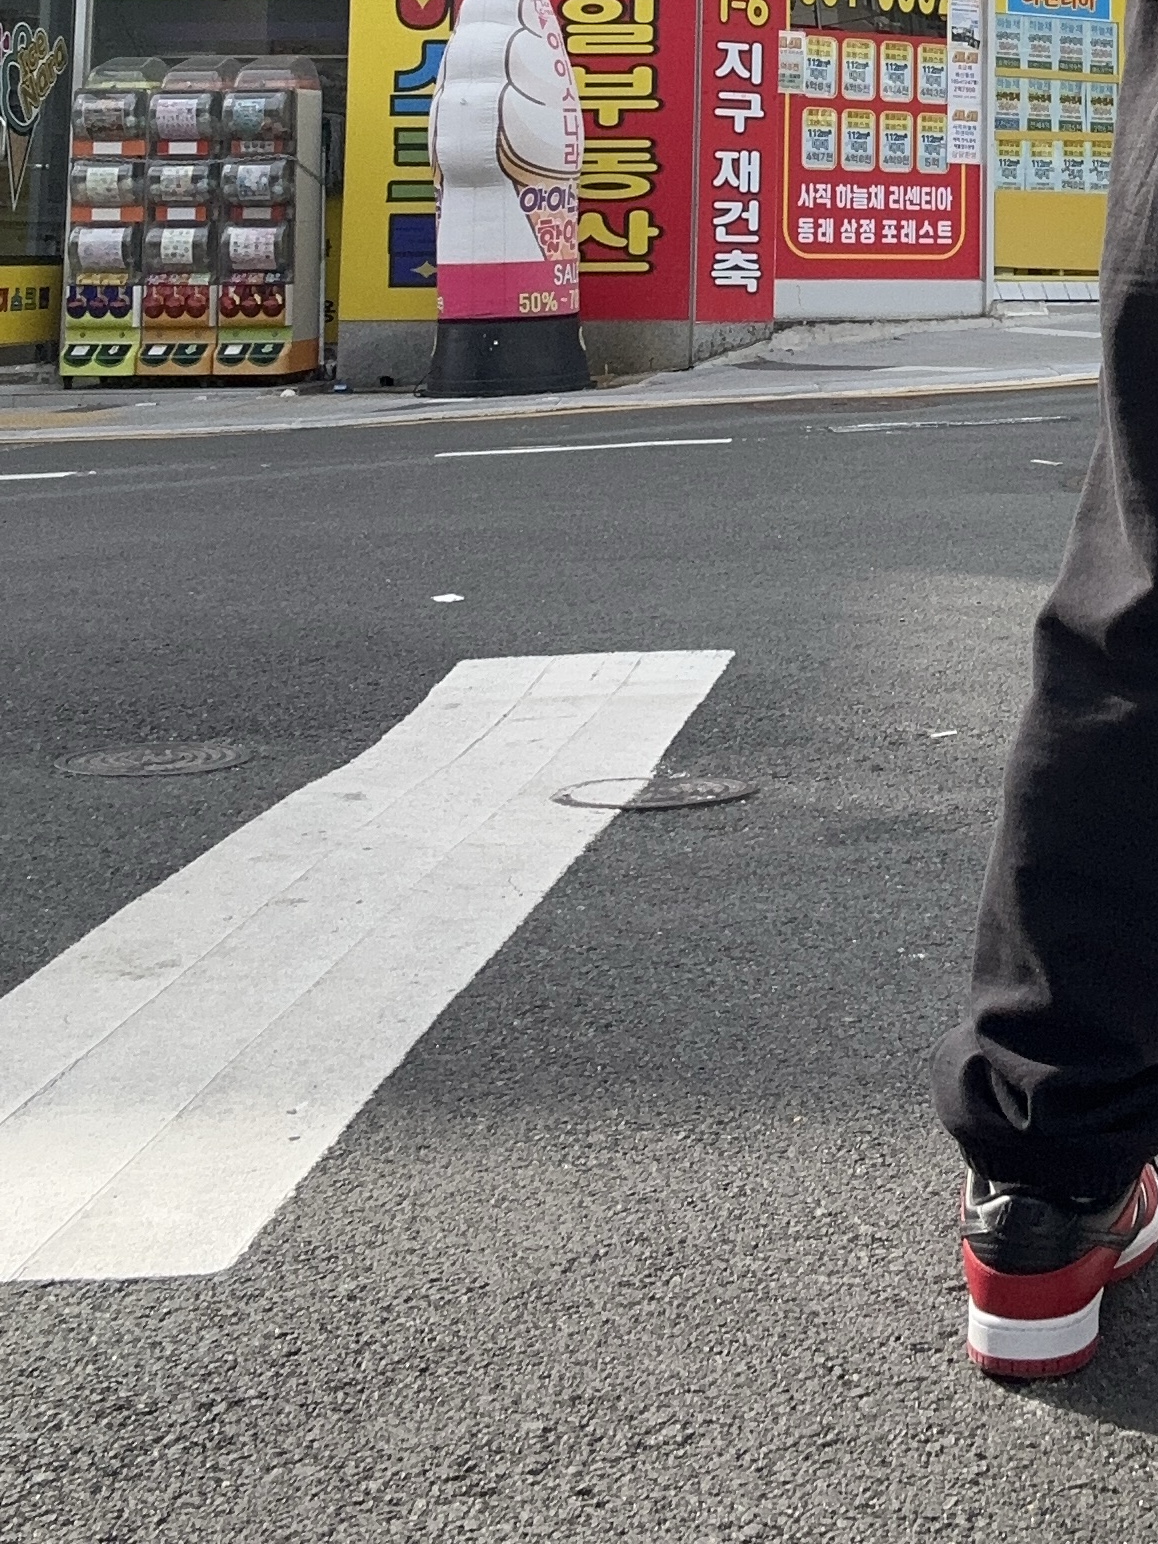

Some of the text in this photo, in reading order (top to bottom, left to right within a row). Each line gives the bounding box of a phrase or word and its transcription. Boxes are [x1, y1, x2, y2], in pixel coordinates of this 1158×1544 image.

[798, 183, 953, 211] 사직 하늘채 리센티아
[798, 218, 953, 244] 동래 삼정 포레스트
[519, 292, 558, 313] 50%
